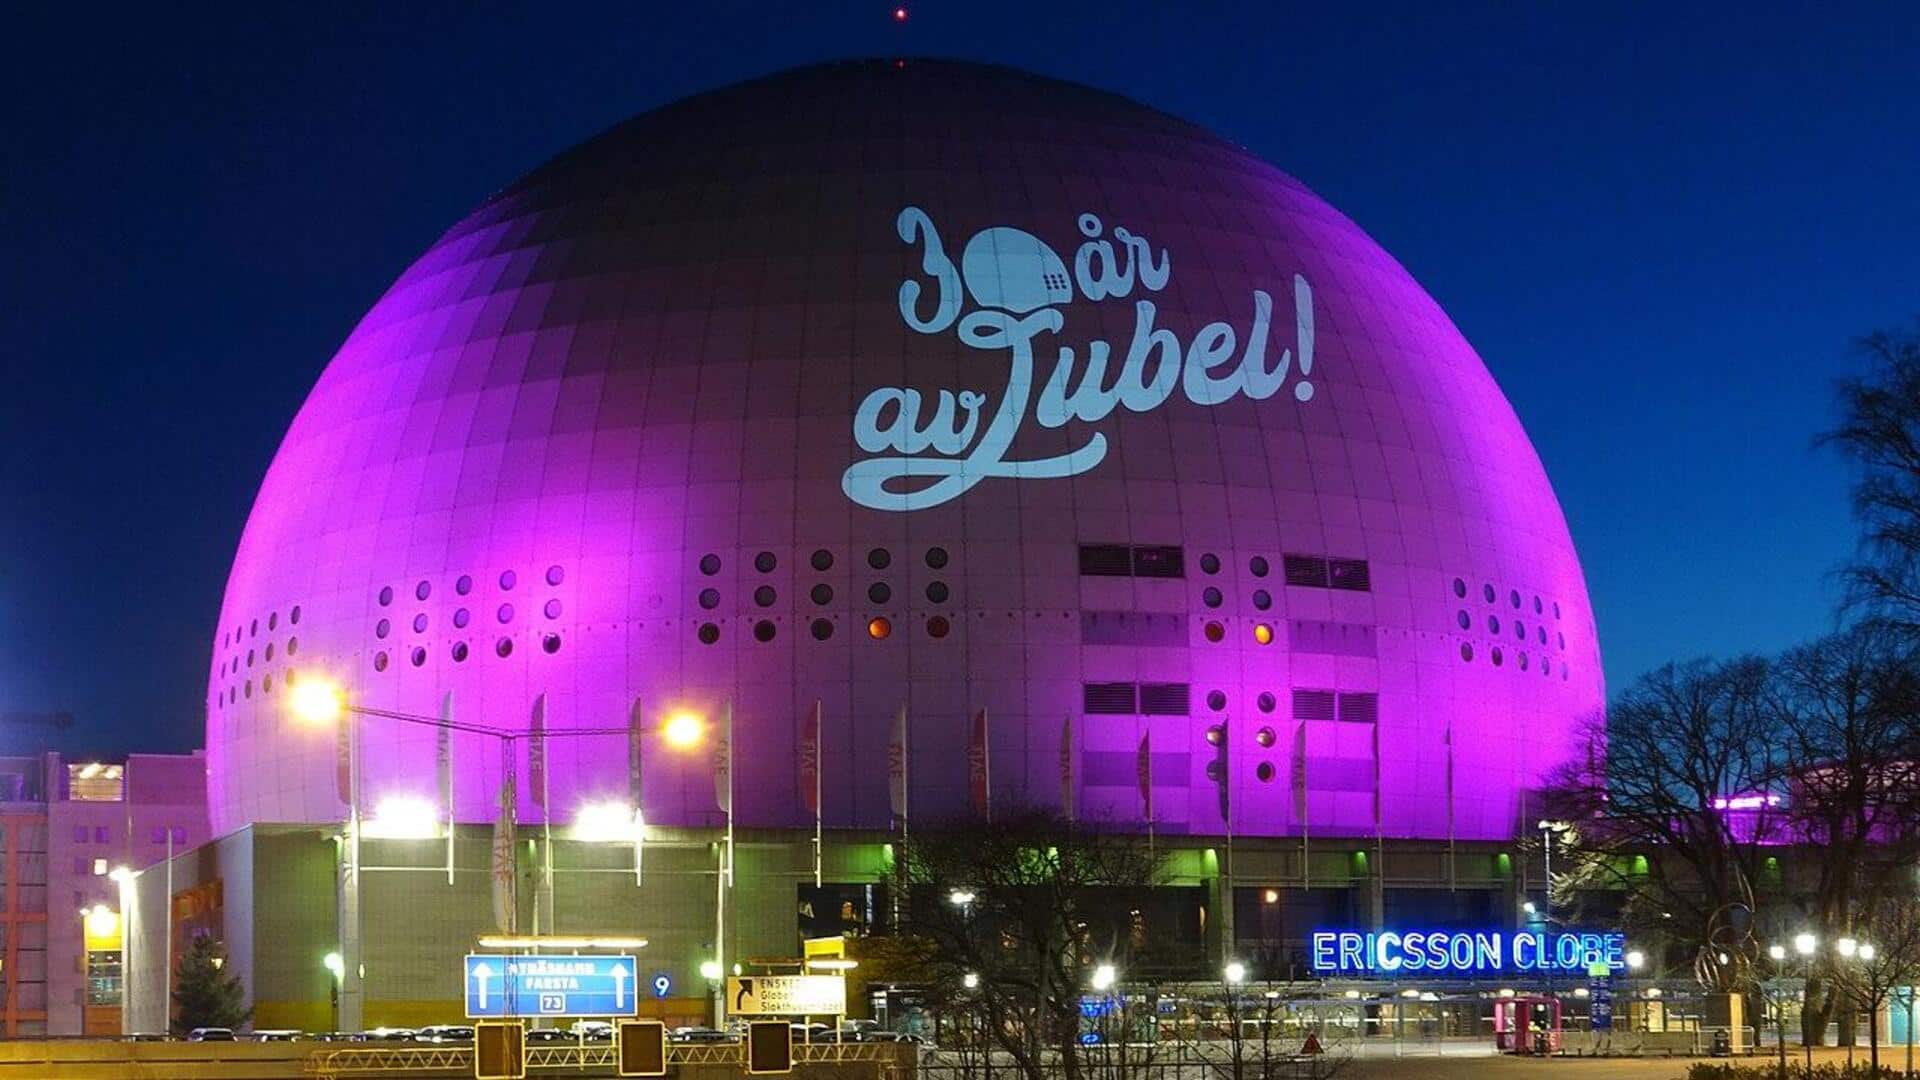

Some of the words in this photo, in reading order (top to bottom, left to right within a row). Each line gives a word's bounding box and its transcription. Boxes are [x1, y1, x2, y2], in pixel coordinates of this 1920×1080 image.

[1075, 213, 1169, 301] år
[854, 388, 985, 455] av
[1313, 932, 1501, 970] ERICSSON
[526, 977, 578, 990] FARSTA
[655, 977, 670, 997] 9
[543, 997, 562, 1009] 73
